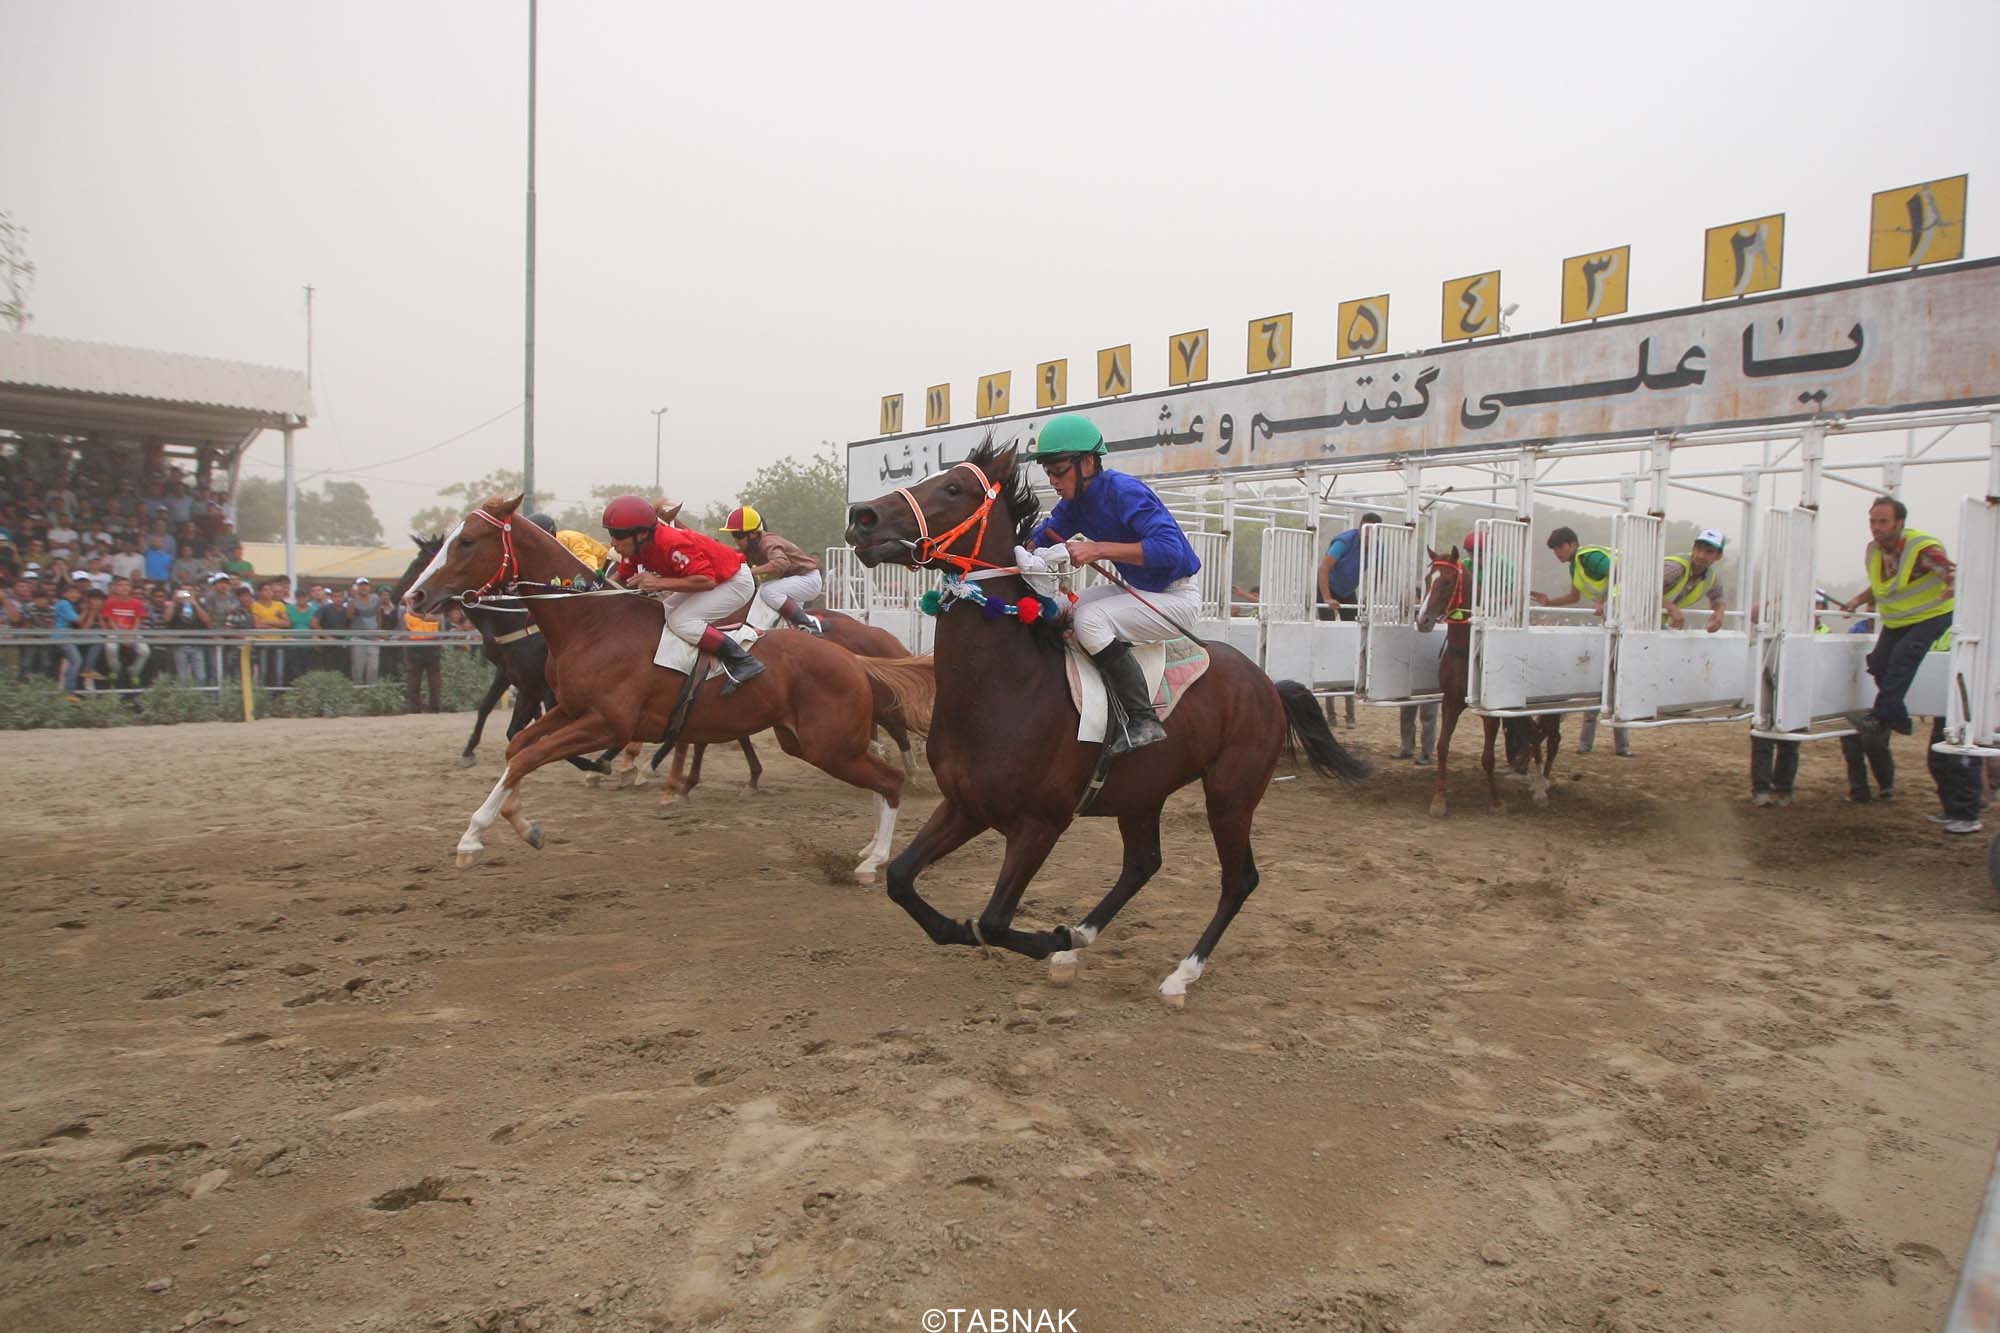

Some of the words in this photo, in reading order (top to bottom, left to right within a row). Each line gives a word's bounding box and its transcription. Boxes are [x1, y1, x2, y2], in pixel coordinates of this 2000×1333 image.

[1582, 254, 1615, 313] ۳
[1461, 337, 1706, 429] علی
[1743, 318, 1864, 403] یا
[1107, 404, 1204, 452] عش
[1251, 366, 1440, 452] گفتیم
[880, 445, 913, 481] شد
